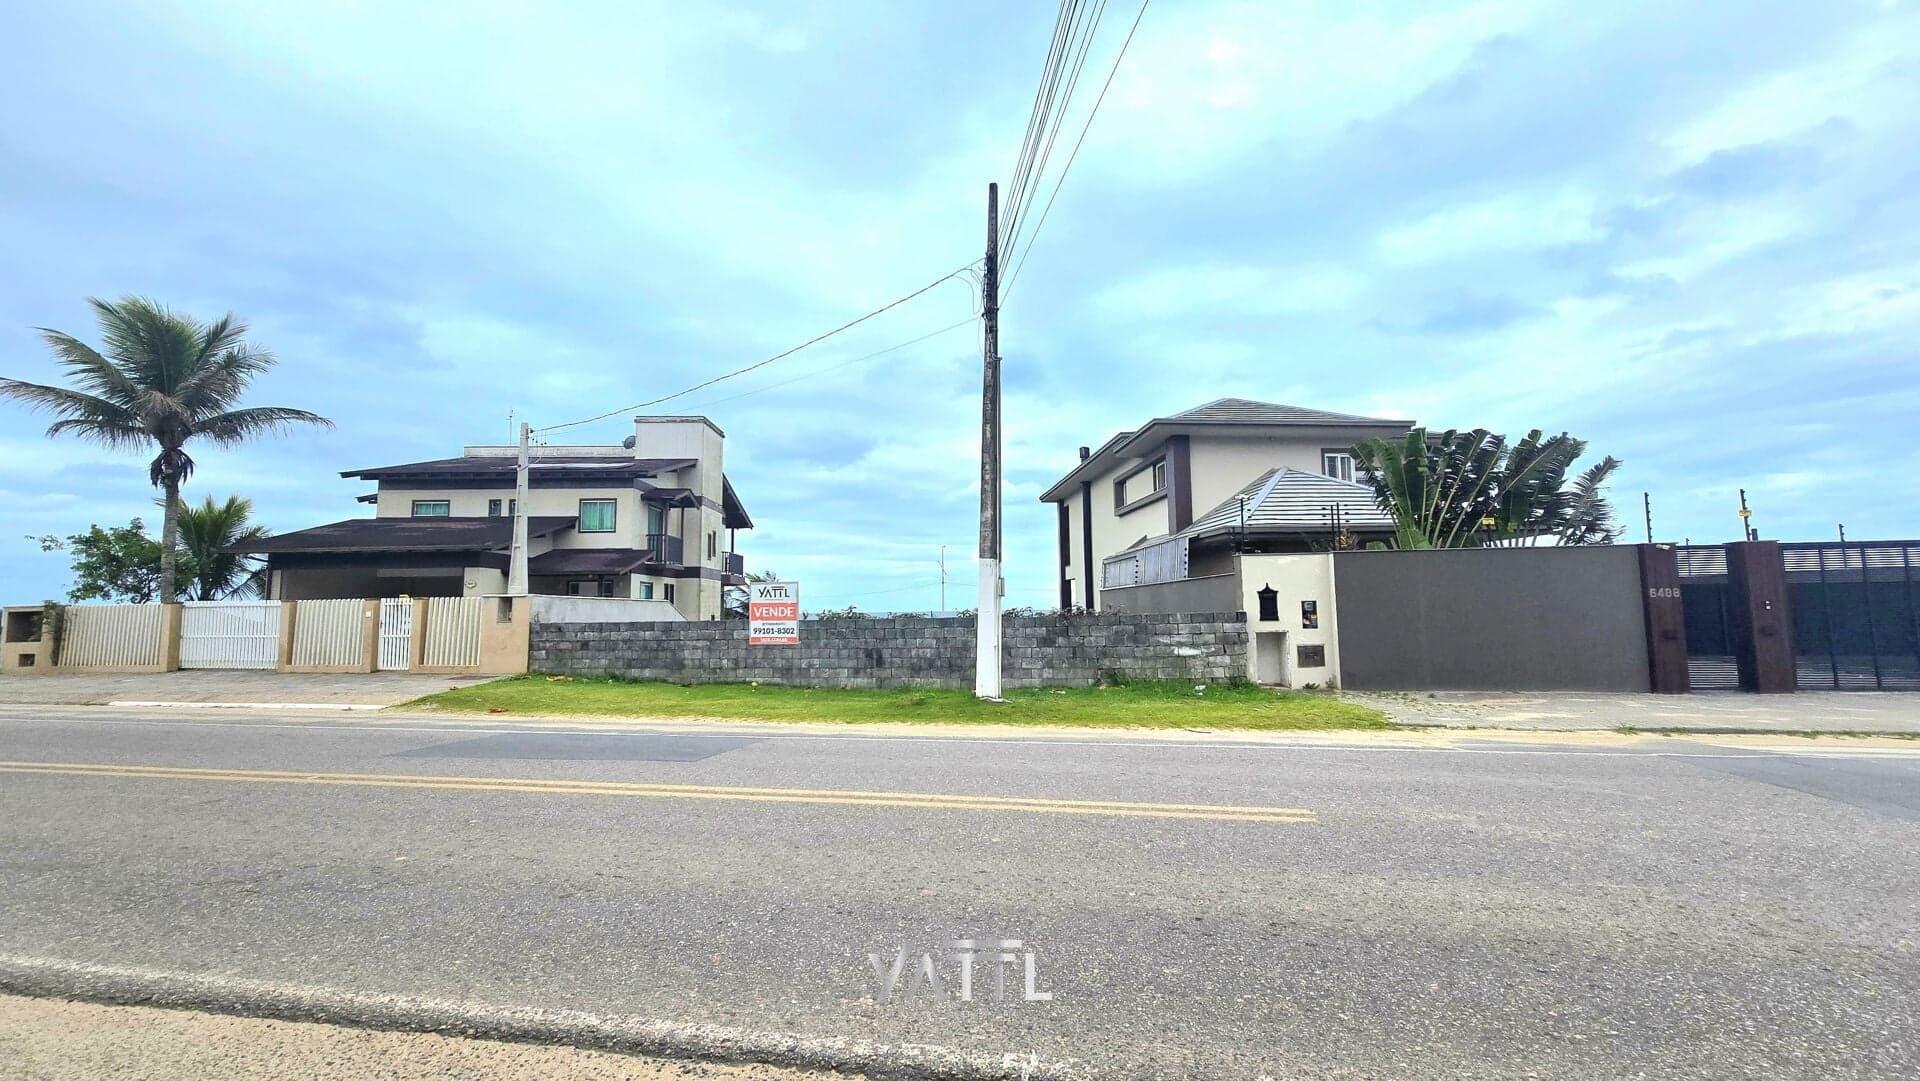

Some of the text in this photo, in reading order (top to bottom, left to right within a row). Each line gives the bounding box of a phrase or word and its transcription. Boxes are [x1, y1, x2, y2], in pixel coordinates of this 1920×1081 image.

[758, 586, 790, 598] YATTL
[753, 606, 794, 617] VENDE
[753, 627, 795, 635] 99101-8302
